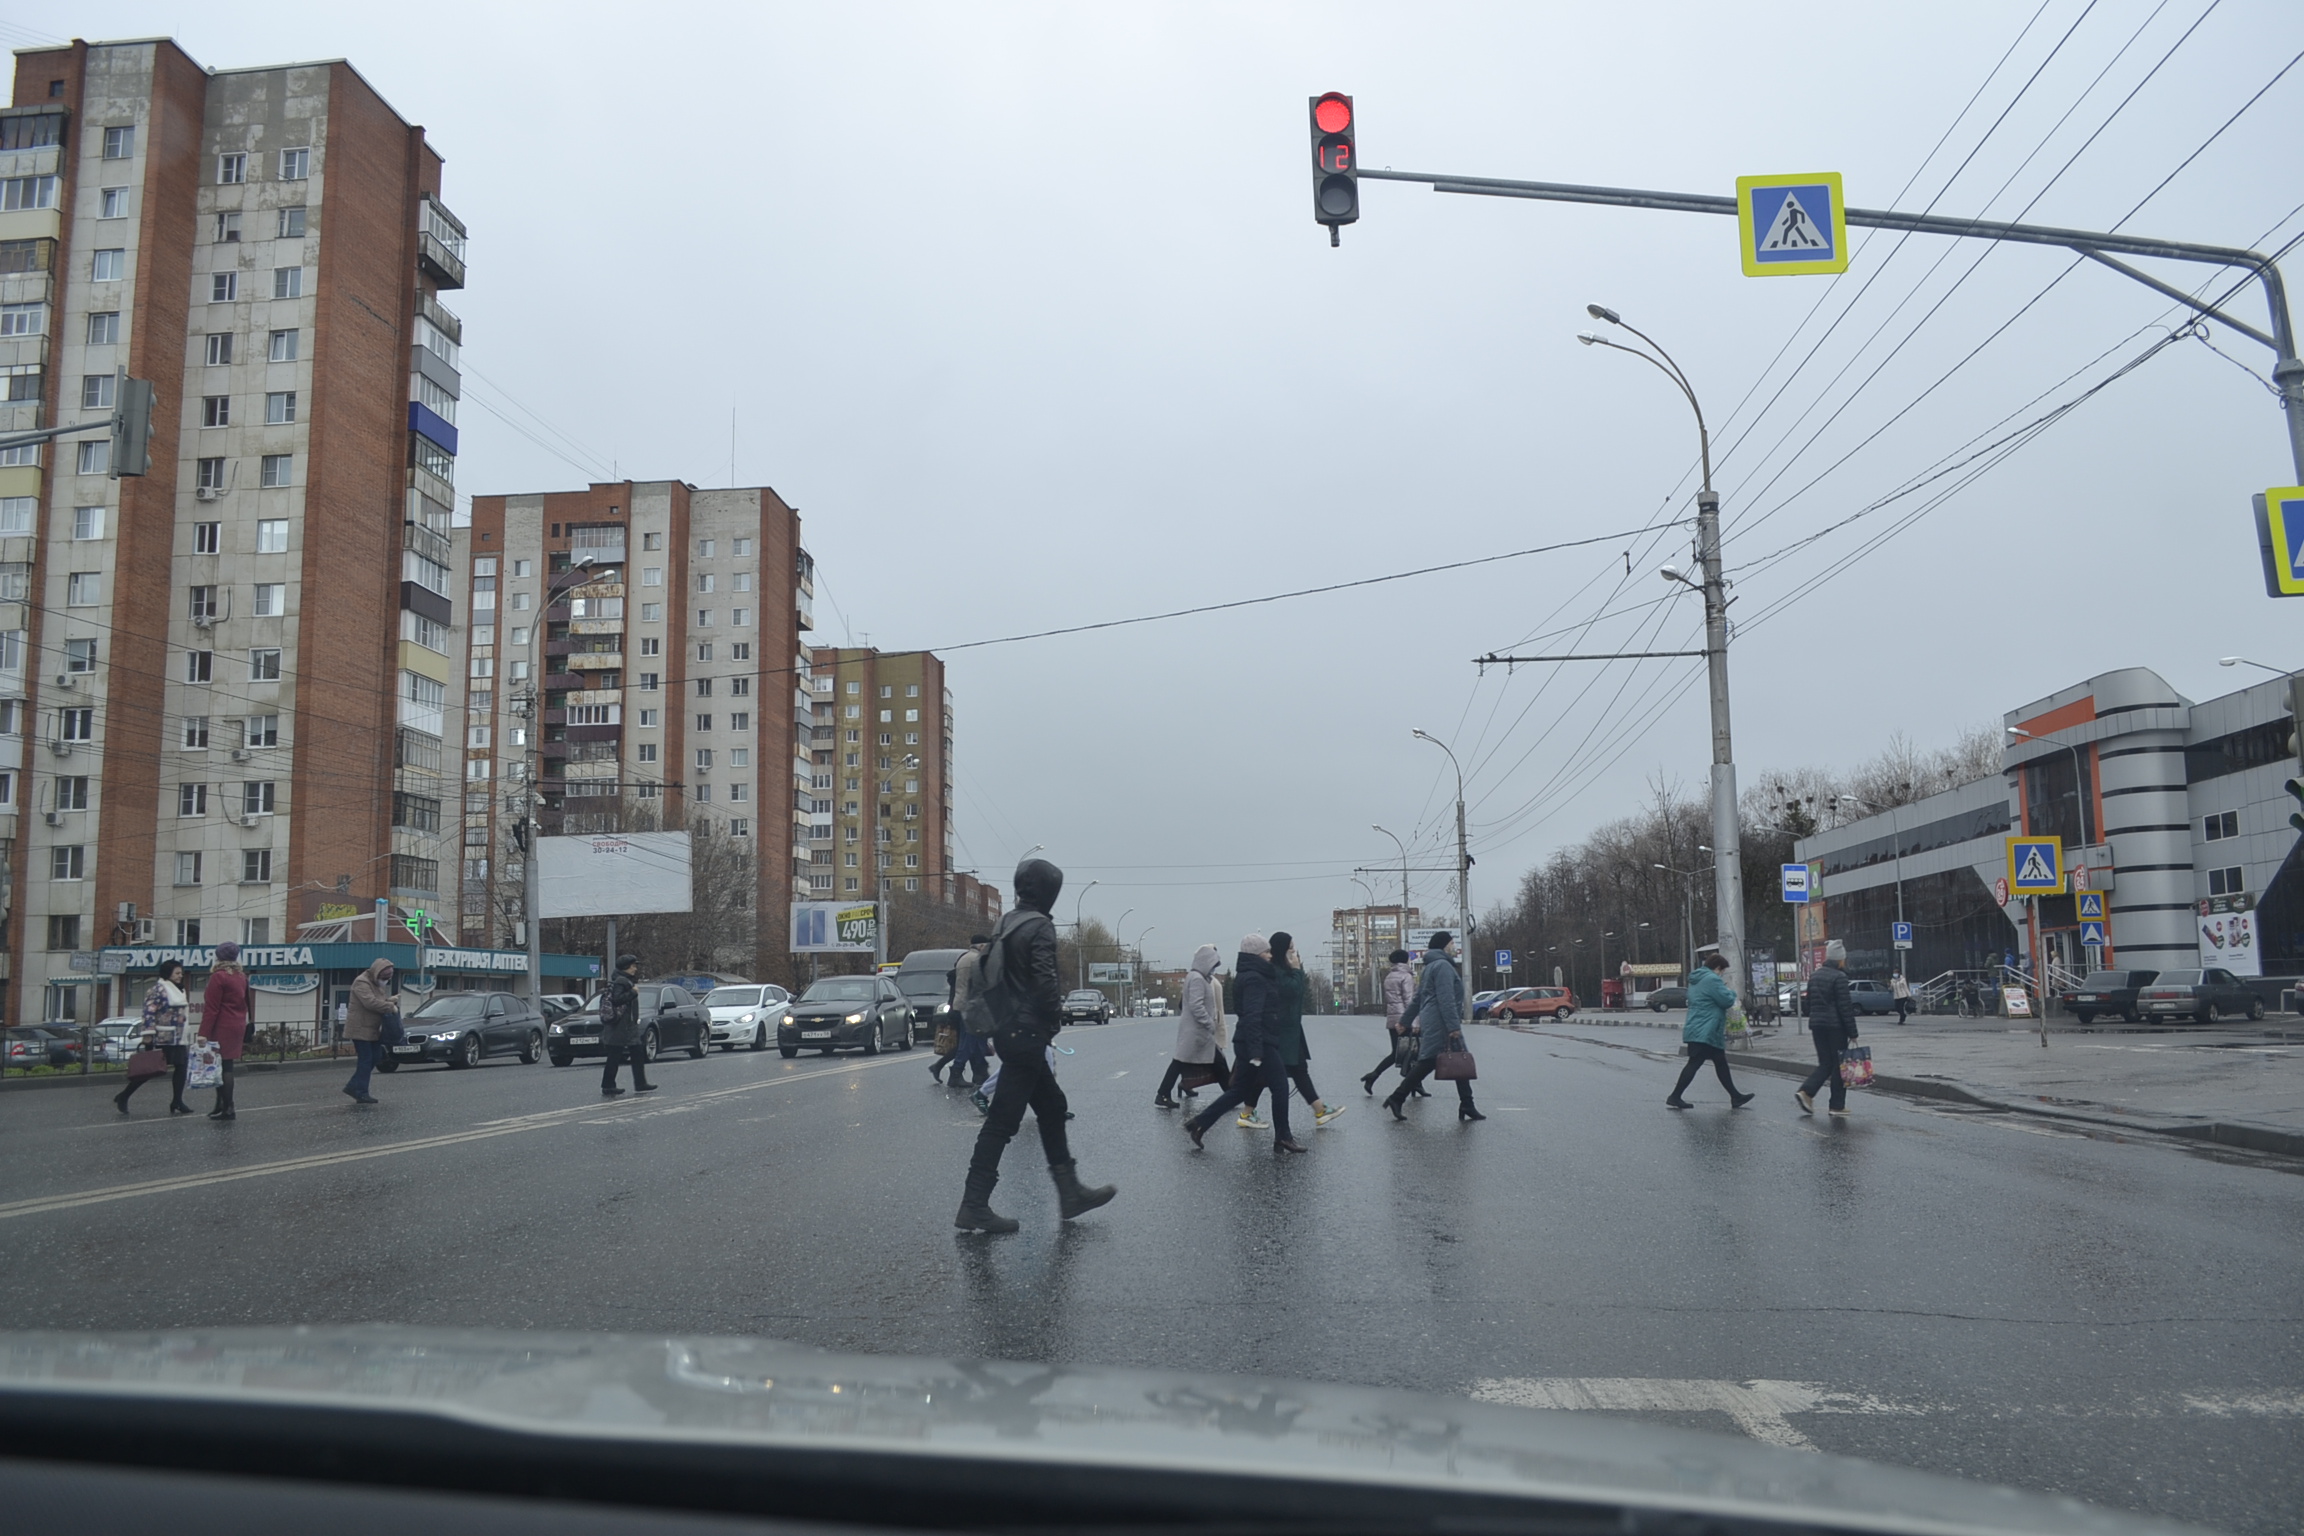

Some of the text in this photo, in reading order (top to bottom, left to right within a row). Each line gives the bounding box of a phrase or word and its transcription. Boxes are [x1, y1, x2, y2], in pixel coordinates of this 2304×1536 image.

[1319, 144, 1350, 169] 12
[842, 919, 866, 939] 490
[1897, 924, 1908, 939] P
[104, 949, 217, 967] ЕЖУРНАЯ
[425, 948, 528, 971] ДЕЖУРНАЯ АПТЕК
[1499, 952, 1508, 965] P
[250, 974, 306, 985] АПТЕКА
